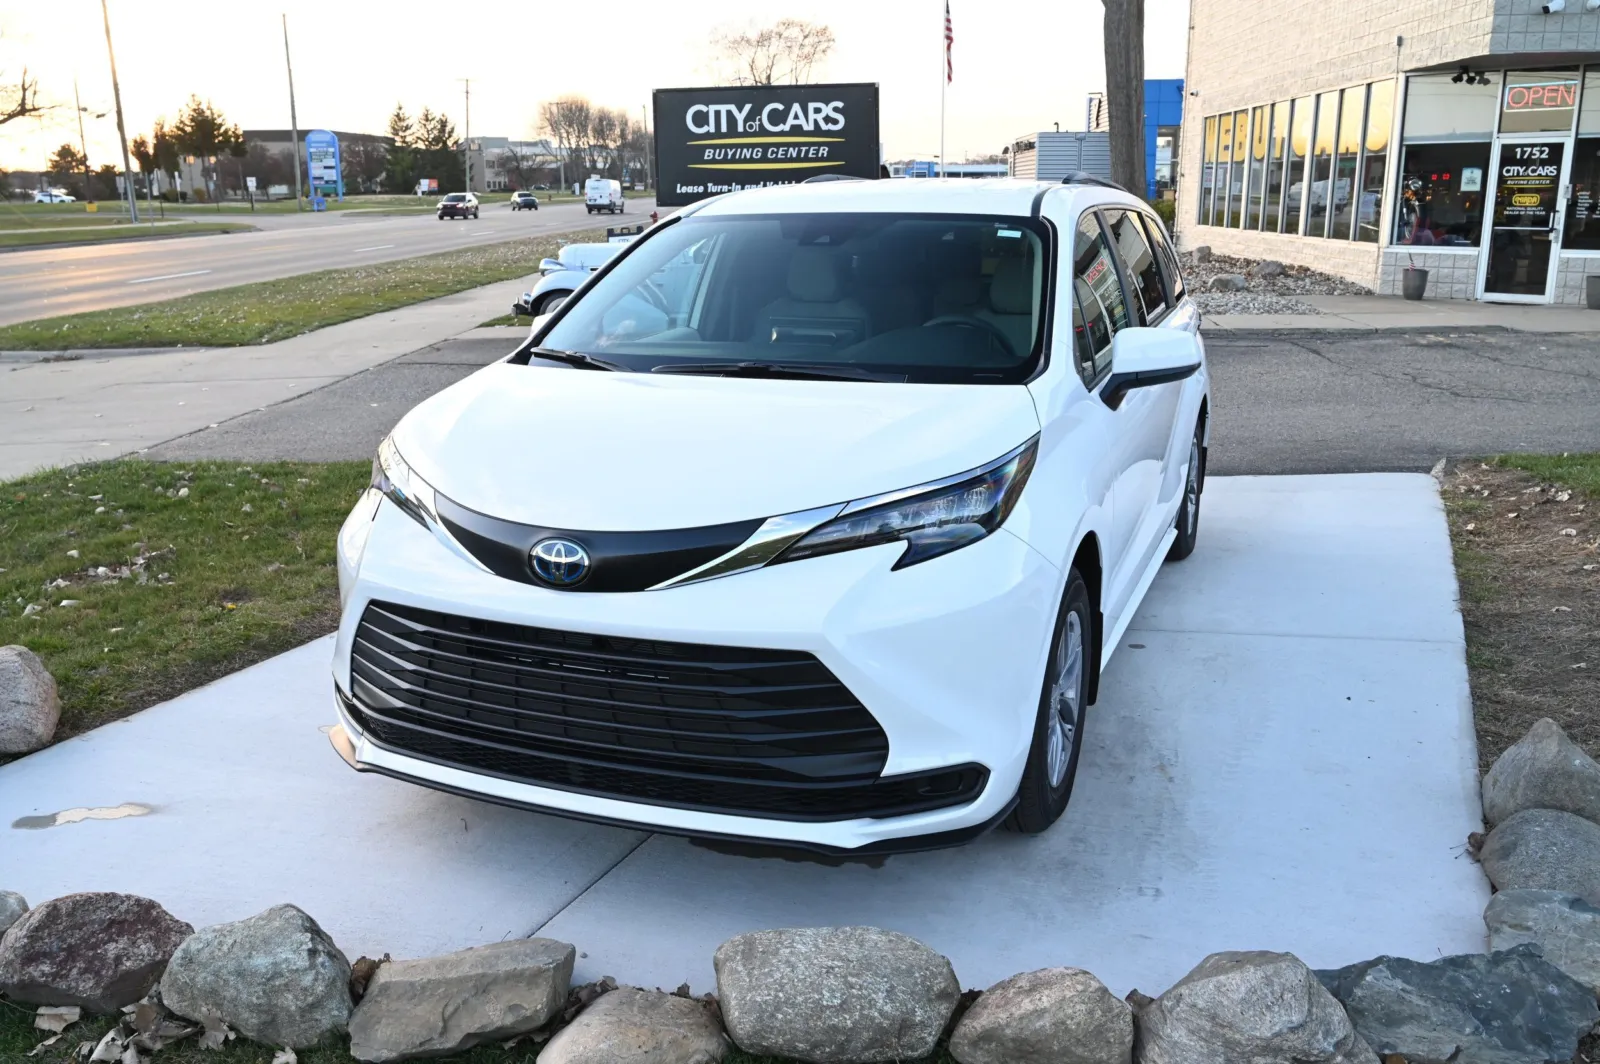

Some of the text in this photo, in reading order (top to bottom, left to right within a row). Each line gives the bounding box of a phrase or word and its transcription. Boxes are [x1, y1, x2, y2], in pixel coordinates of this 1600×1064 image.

[1508, 86, 1575, 108] OPEN
[685, 101, 846, 134] CITY of CARS
[703, 146, 829, 160] BUYING CENTER
[1515, 146, 1550, 159] 1752
[1502, 165, 1527, 177] CITY
[1528, 165, 1558, 176] CARS
[676, 183, 704, 194] Lease
[707, 182, 742, 193] Turn-In
